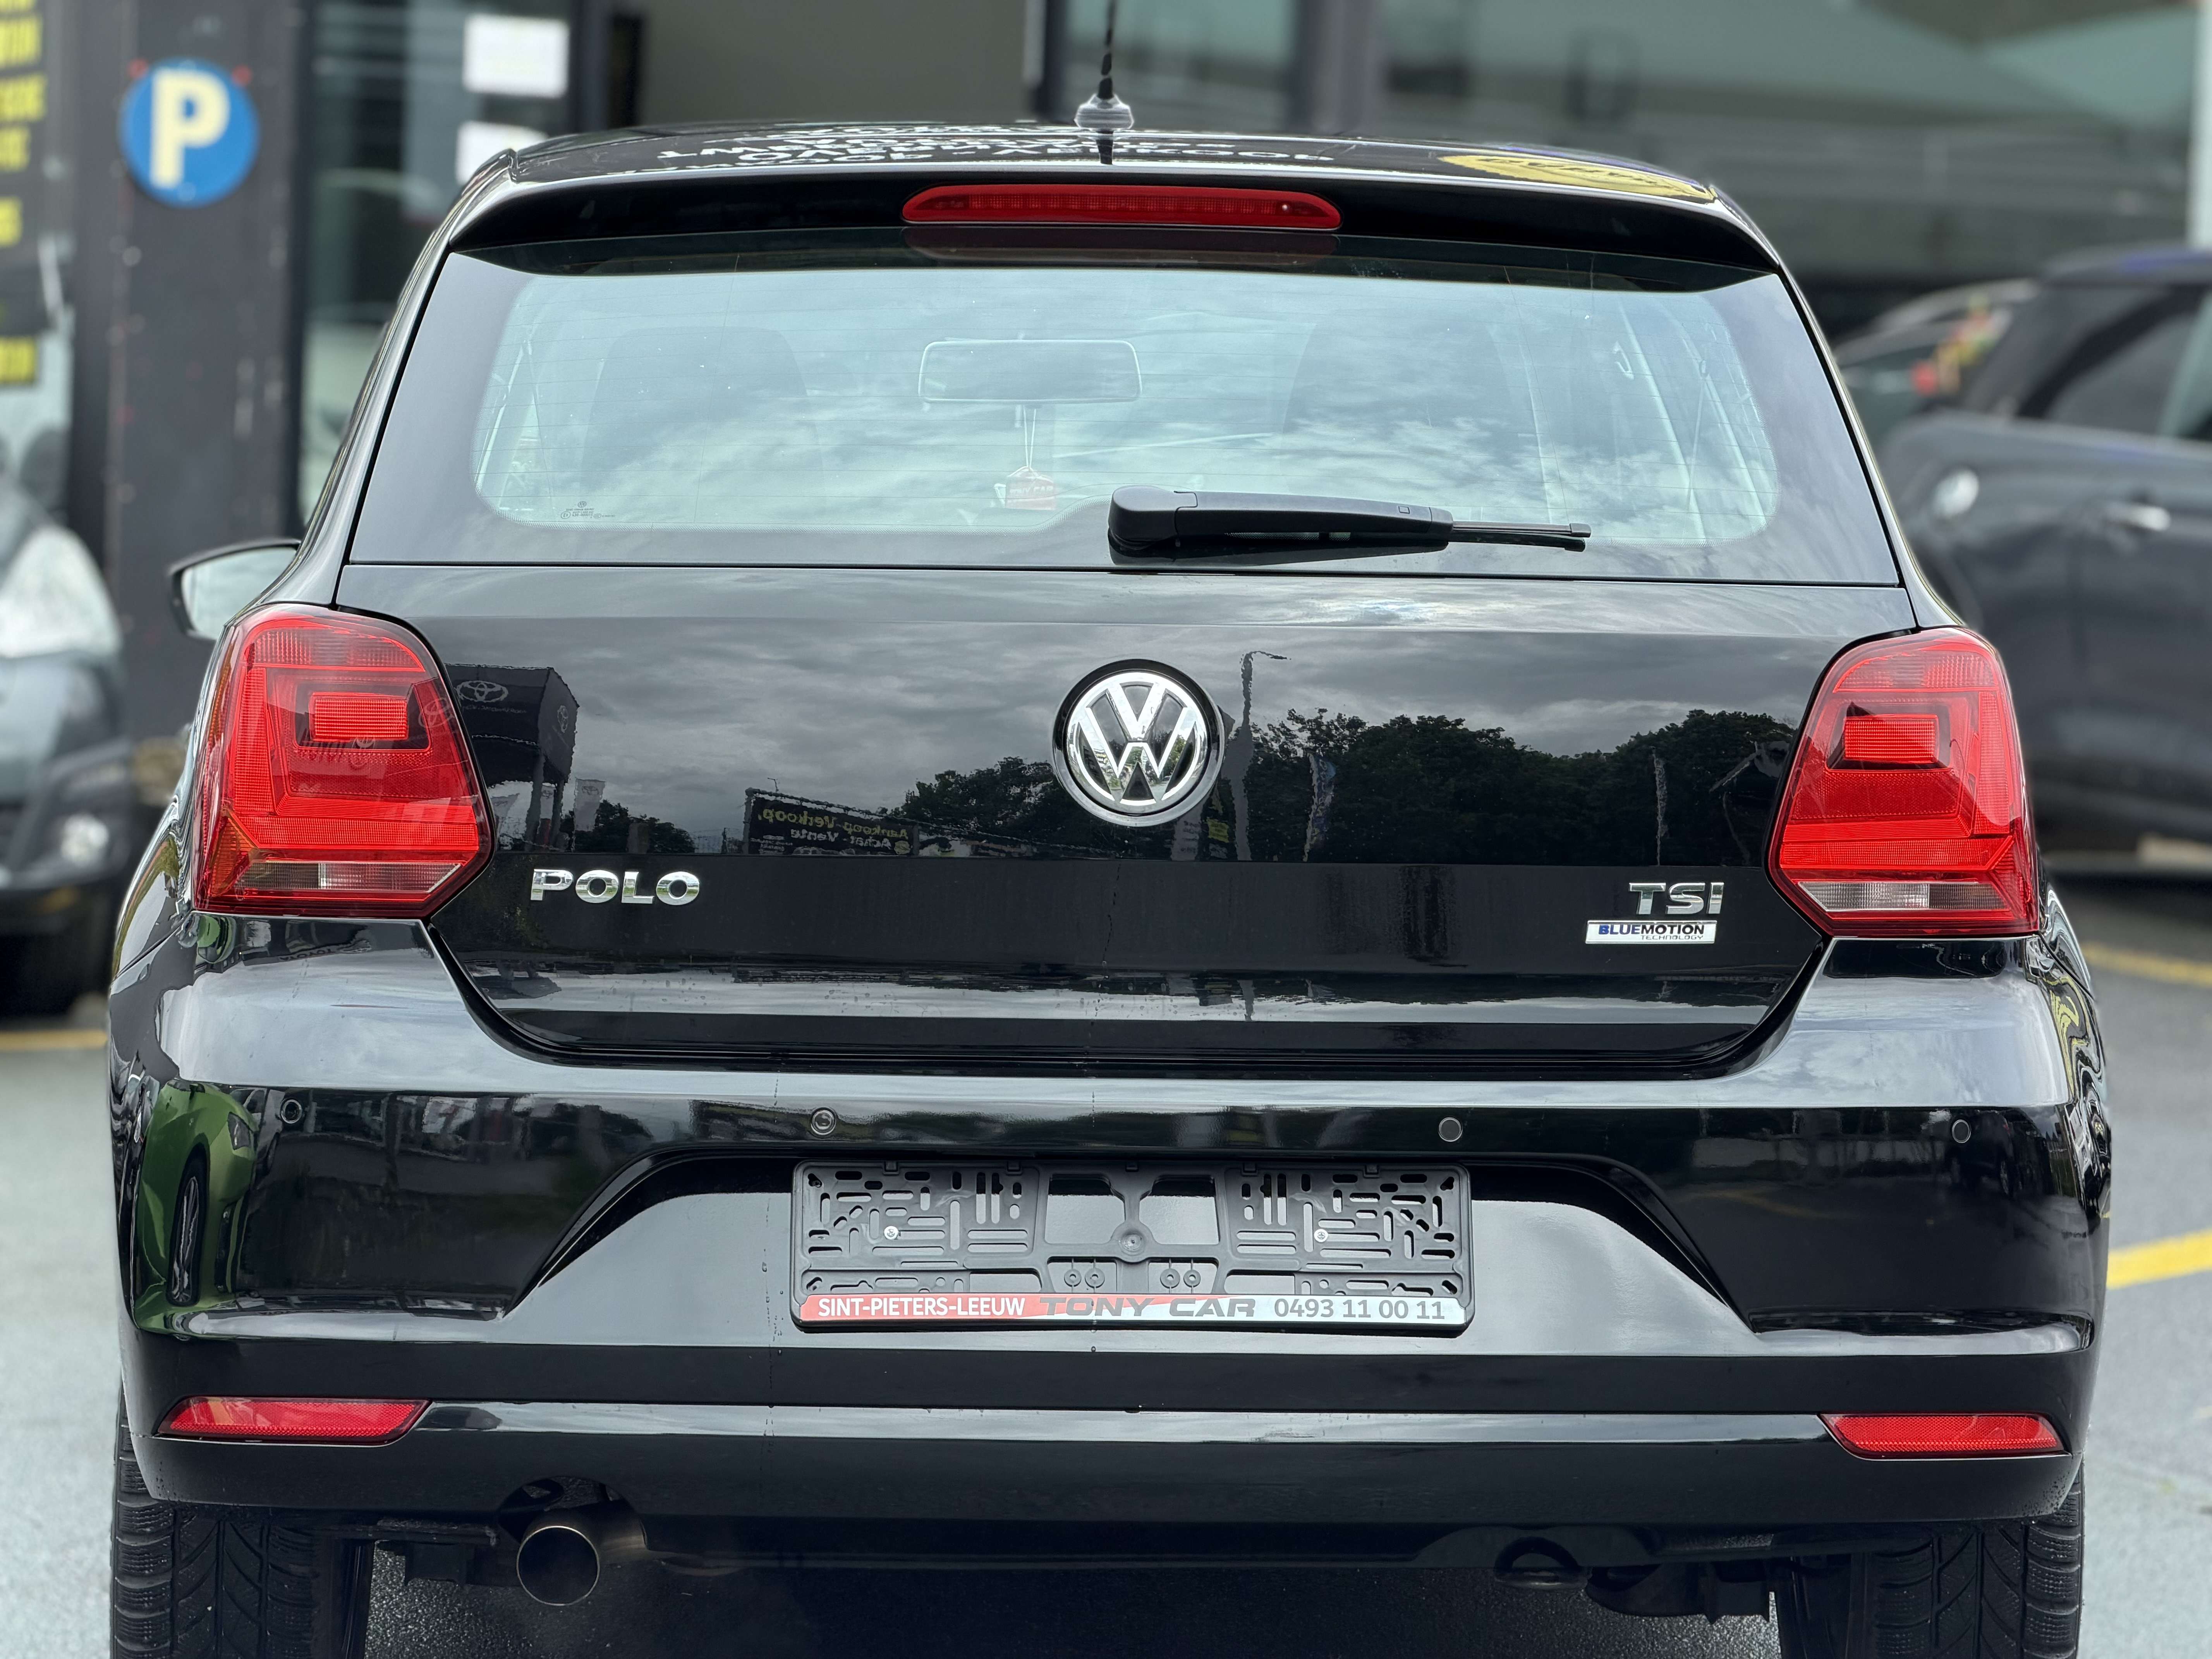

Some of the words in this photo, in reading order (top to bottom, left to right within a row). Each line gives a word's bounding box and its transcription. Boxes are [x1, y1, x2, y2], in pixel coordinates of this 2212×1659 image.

[149, 67, 230, 189] P
[531, 869, 700, 905] POLO
[1628, 882, 1724, 915] TSI
[1598, 925, 1704, 935] BLUEMOTION
[818, 1297, 1026, 1317] SINT-PIETERS-LEEUW
[1039, 1297, 1156, 1317] TONY
[1169, 1298, 1256, 1317] CAR
[1274, 1298, 1334, 1318] 0493
[1343, 1299, 1371, 1318] 11
[1379, 1300, 1409, 1319] 00
[1417, 1300, 1445, 1319] 11
